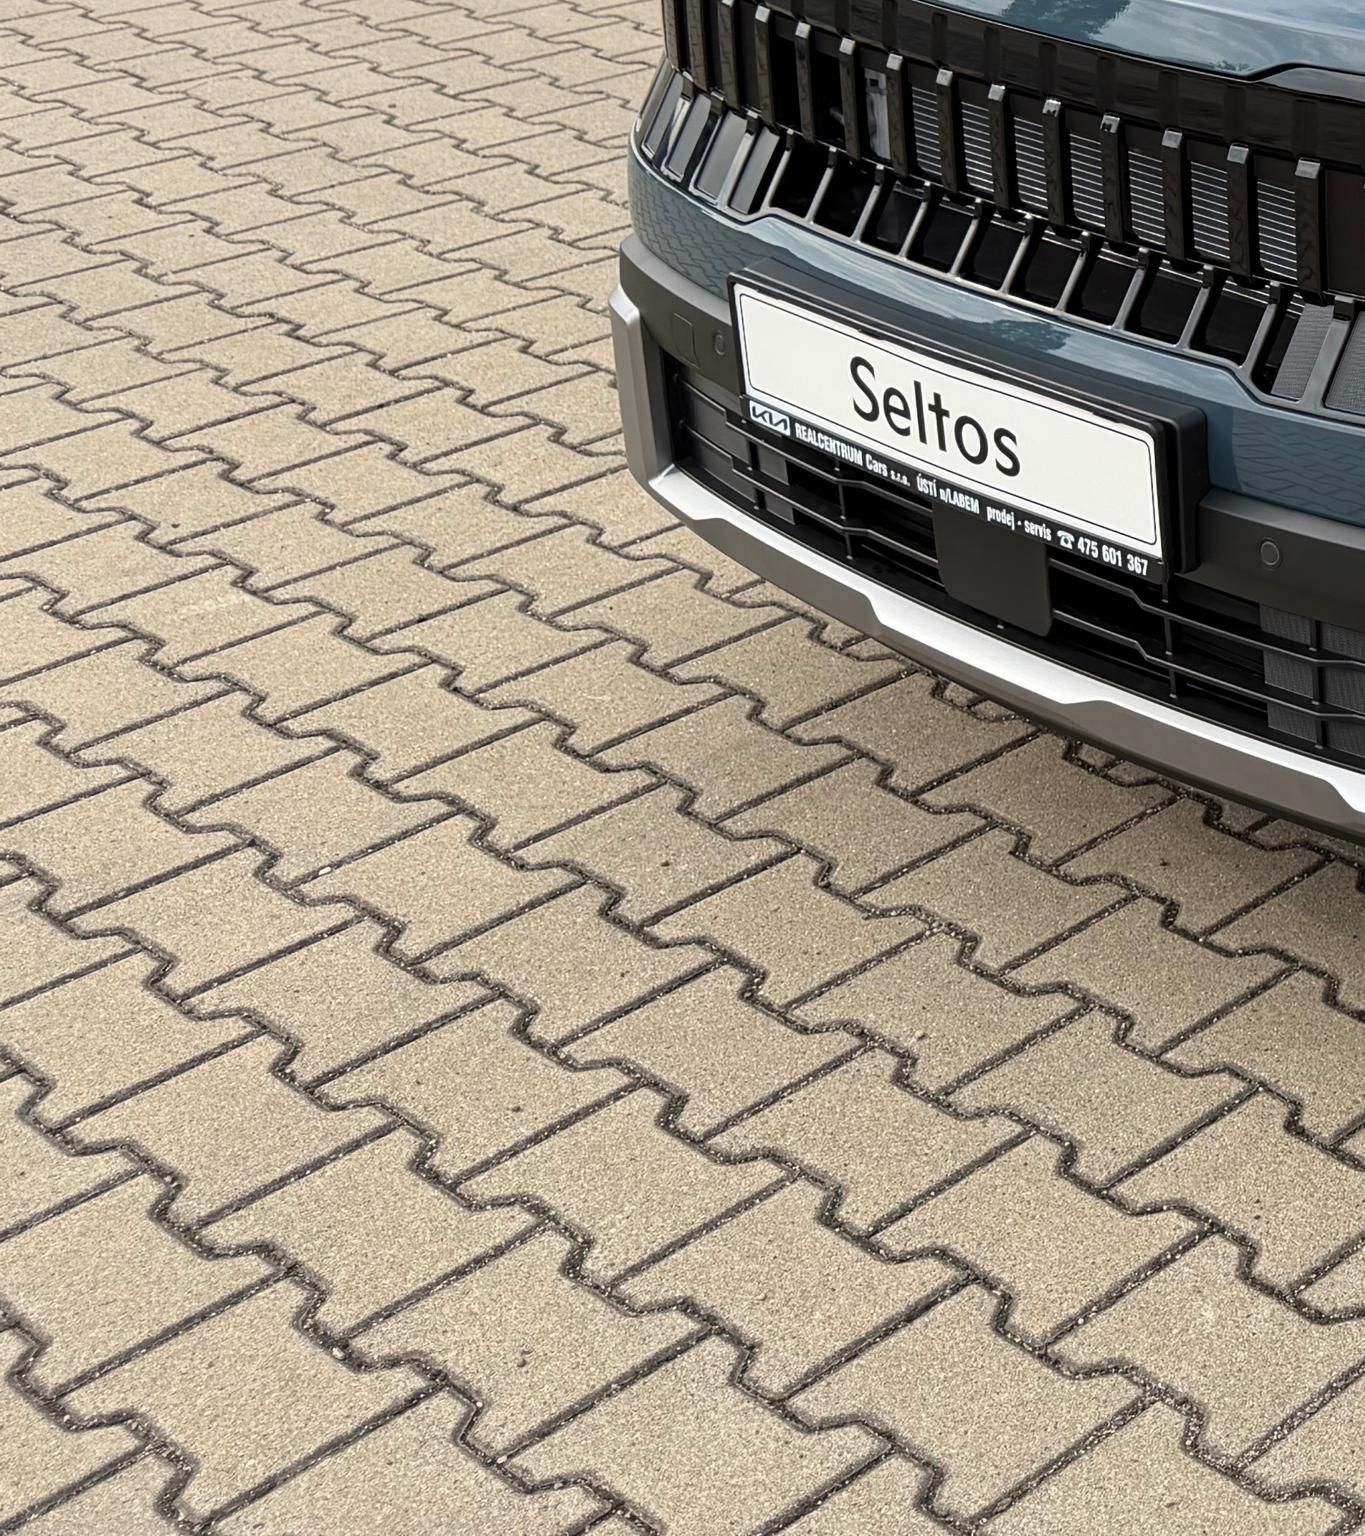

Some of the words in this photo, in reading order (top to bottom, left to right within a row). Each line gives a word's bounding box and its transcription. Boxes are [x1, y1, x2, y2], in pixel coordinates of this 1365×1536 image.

[850, 356, 1021, 477] Seltos
[752, 405, 788, 431] KIA
[794, 422, 863, 466] REALCENTRUM
[865, 454, 888, 477] Cars
[916, 475, 937, 498] ÚSTÍ
[939, 487, 980, 514] n/LABEM
[986, 505, 1015, 531] prodej
[1024, 519, 1052, 542] servis
[1077, 536, 1099, 559] 475
[1102, 545, 1123, 568] 601
[1127, 554, 1149, 576] 367
